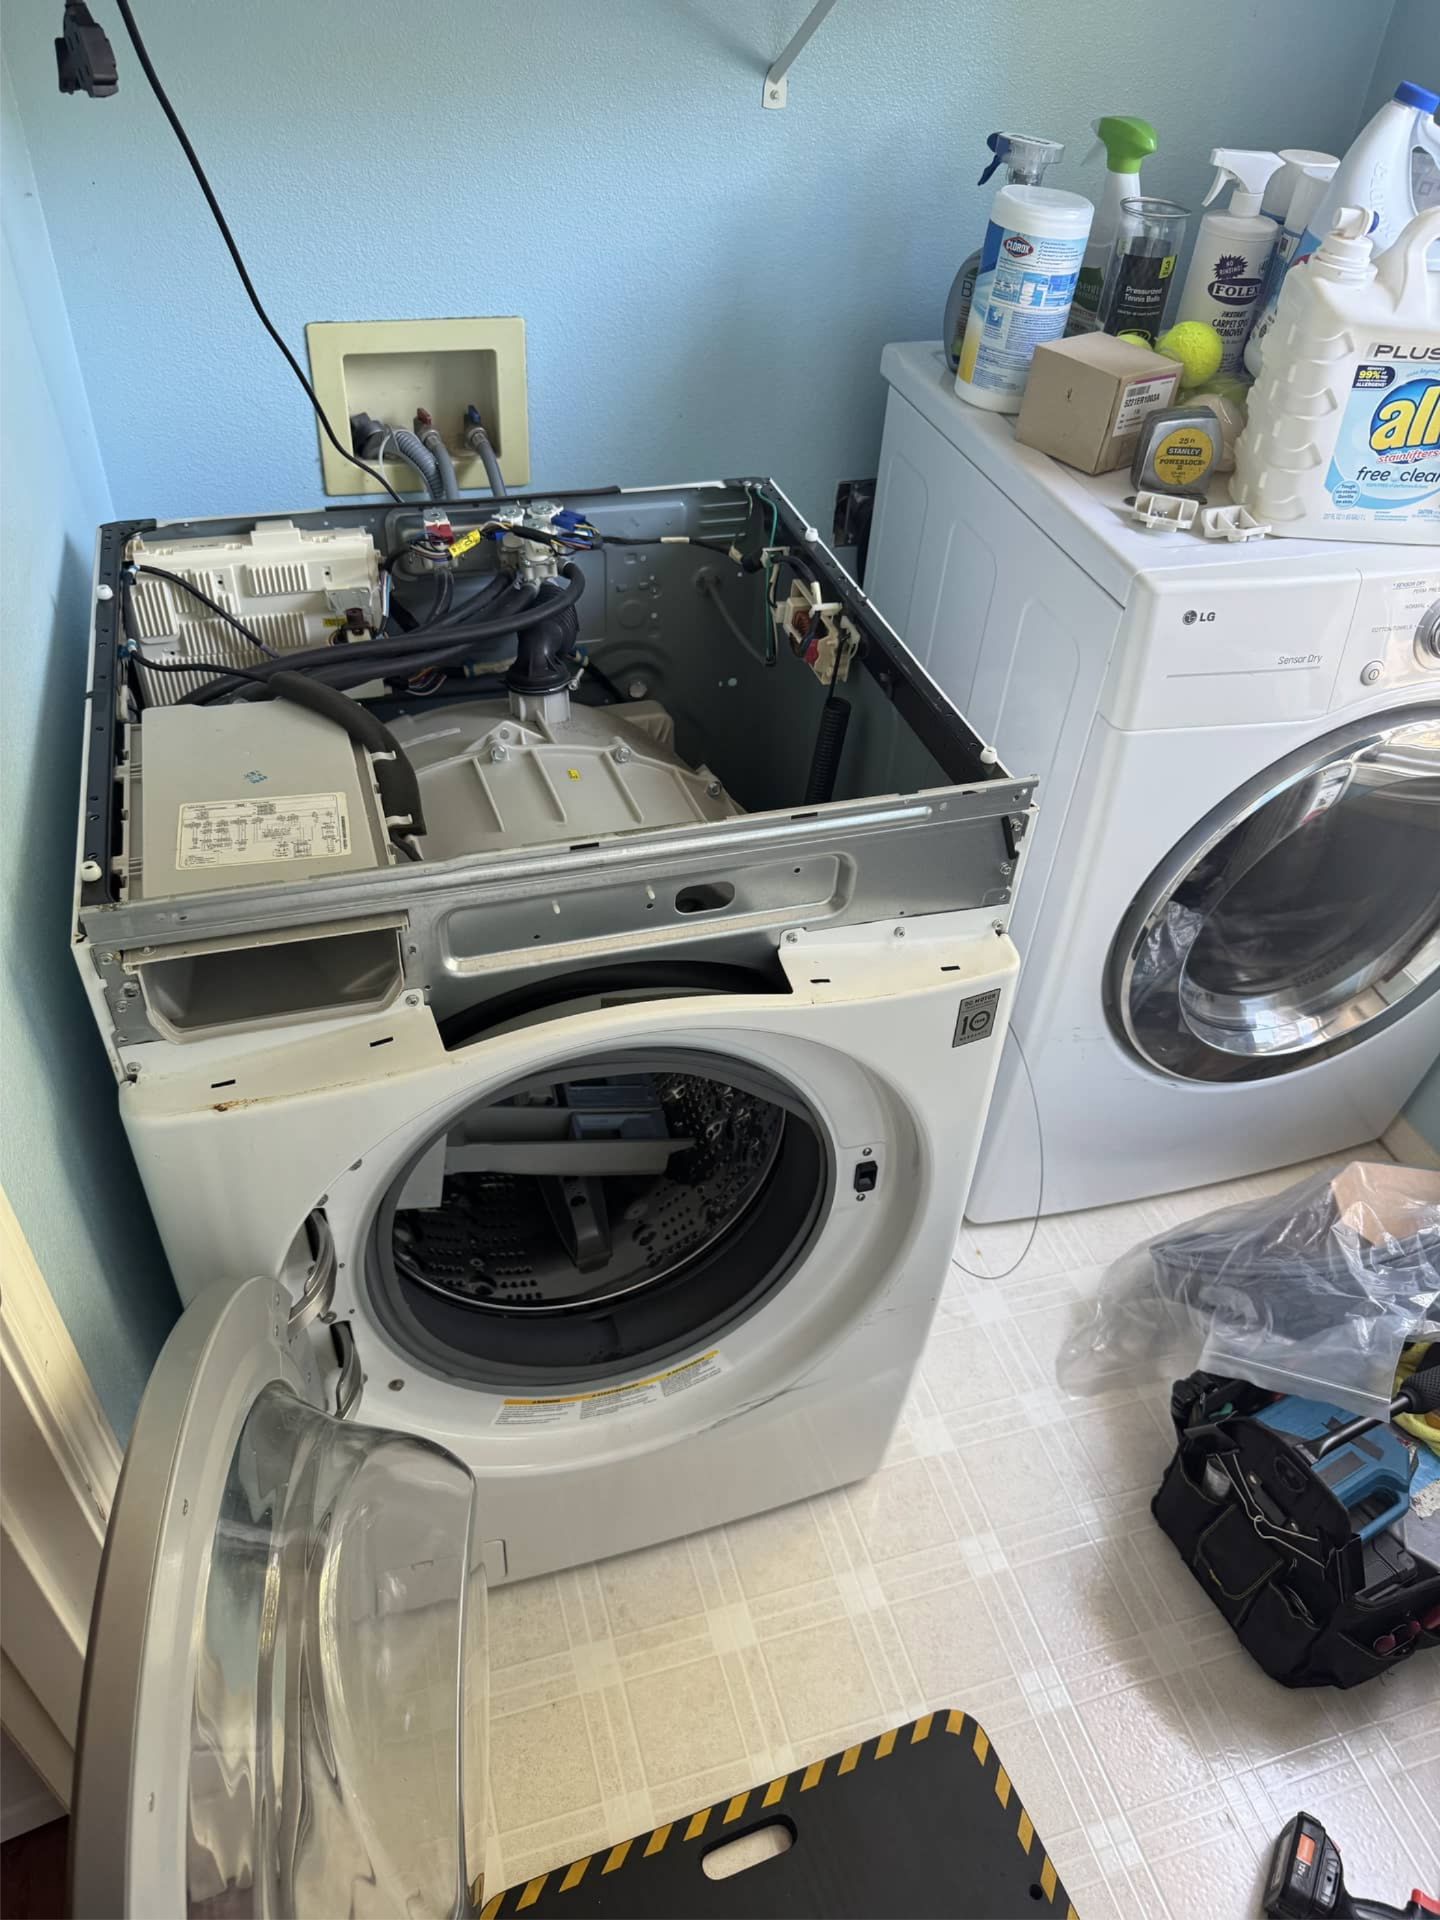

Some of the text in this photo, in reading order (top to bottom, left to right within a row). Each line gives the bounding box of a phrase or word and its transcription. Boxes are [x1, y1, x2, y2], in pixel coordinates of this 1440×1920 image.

[1006, 240, 1030, 254] CLOROX
[1165, 260, 1171, 269] 3
[1126, 285, 1163, 295] Pressurized
[1124, 293, 1161, 303] Tennis Balls
[1212, 318, 1237, 328] CARPET
[1374, 344, 1440, 360] PLUS
[1359, 370, 1380, 379] 99%
[1369, 384, 1440, 451] all
[1168, 447, 1201, 455] STANLEY
[1377, 449, 1438, 464] stainlifters
[1356, 466, 1440, 483] free clear
[1199, 612, 1216, 622] LG
[1278, 654, 1323, 665] Sensor Dry
